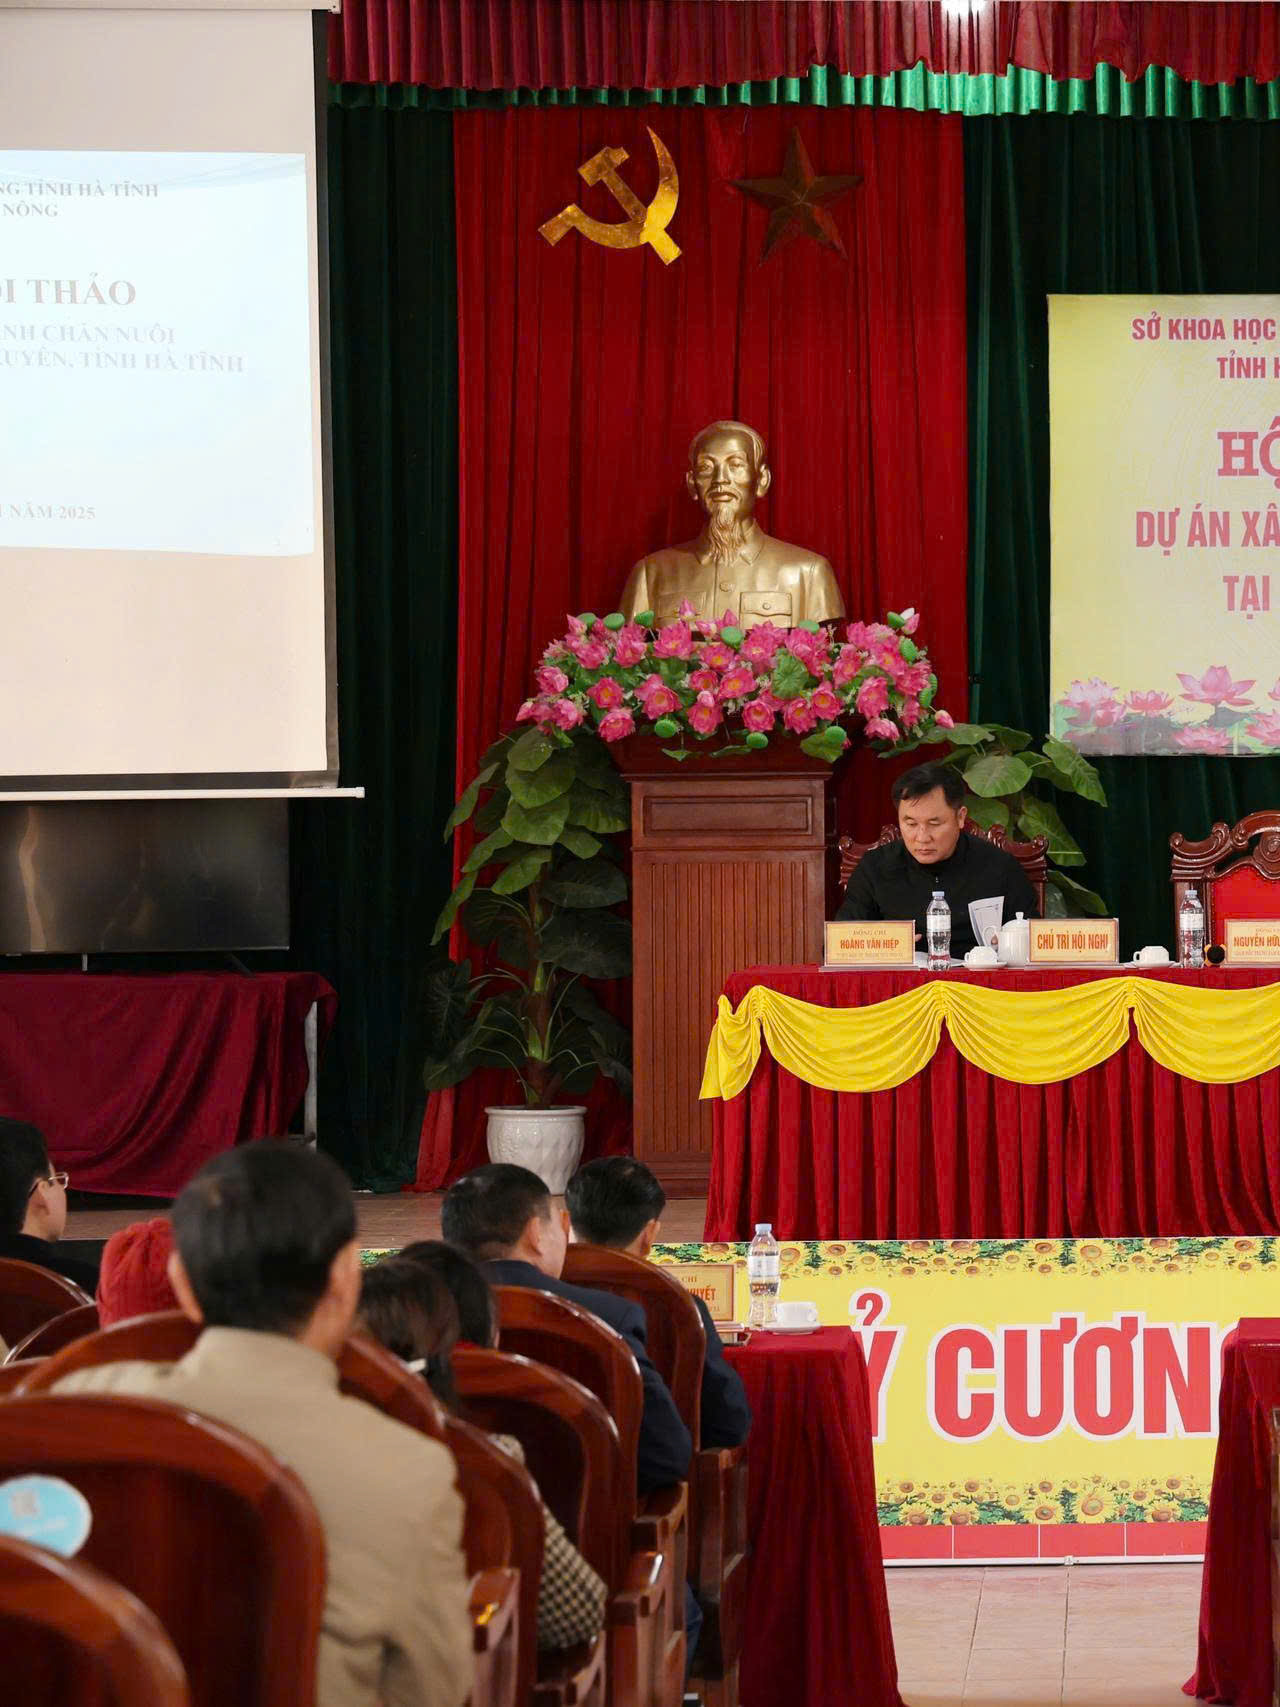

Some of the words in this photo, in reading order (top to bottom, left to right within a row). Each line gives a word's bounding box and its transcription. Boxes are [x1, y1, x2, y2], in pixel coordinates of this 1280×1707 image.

[79, 180, 105, 197] HÀ
[4, 201, 59, 217] NÔNG
[26, 272, 137, 306] THẢO
[1132, 311, 1161, 340] SỞ
[1169, 318, 1226, 340] KHOA
[1233, 318, 1275, 344] HỌC
[0, 347, 74, 368] UYÊN,
[1217, 350, 1266, 379] TỈNH
[58, 505, 97, 520] 2025
[1136, 508, 1181, 556] DỰ
[1187, 503, 1230, 548] ÁN
[1223, 574, 1269, 620] TẠI
[840, 938, 865, 949] HOÀNG
[866, 937, 881, 949] VĂN
[882, 937, 900, 951] HIỆP
[1037, 929, 1054, 950] CHỦ
[1056, 930, 1069, 950] TRÌ
[1071, 930, 1086, 953] HỘI
[1088, 933, 1109, 953] NGHỊ
[1233, 934, 1265, 947] NGUYỄN
[934, 1317, 1225, 1437] CƯƠN
